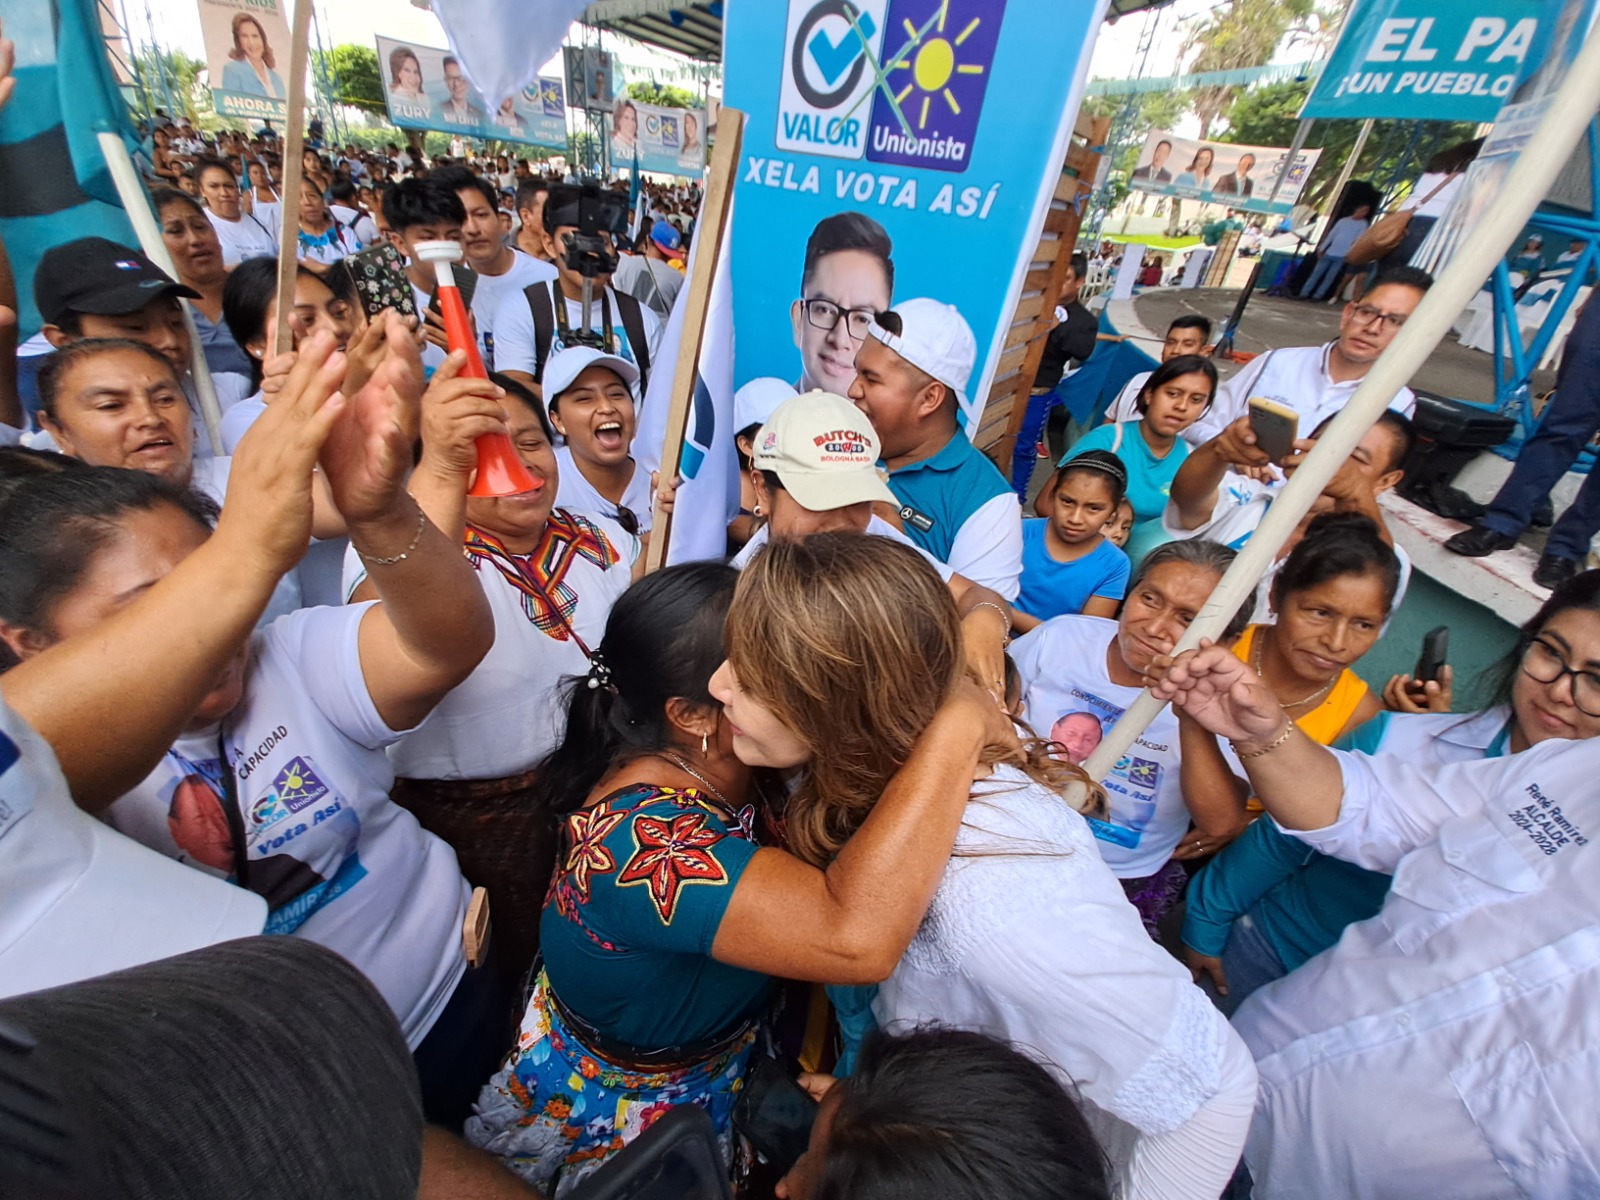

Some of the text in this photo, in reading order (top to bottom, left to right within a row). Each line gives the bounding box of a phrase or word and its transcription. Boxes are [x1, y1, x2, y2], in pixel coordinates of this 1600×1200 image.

[1365, 17, 1438, 62] EL
[1334, 72, 1515, 98] ¡UN PUEBLO
[223, 96, 275, 113] AHORA
[392, 103, 431, 119] ZURY
[783, 112, 860, 147] VALOR
[873, 125, 966, 161] Unionista
[744, 157, 1002, 219] XELA VOTA ASÍ
[813, 429, 872, 448] BUTCH'S
[820, 455, 854, 463] BOLOGNA
[238, 725, 288, 780] CAPACIDAD
[1134, 737, 1168, 752] APACIDAD
[290, 786, 326, 811] Unionista
[1101, 779, 1128, 795] ota
[257, 797, 342, 855] Vota Así
[1522, 805, 1571, 847] ALCALDE
[1525, 783, 1588, 846] René Ramírez
[1508, 810, 1558, 856] 2024-2028
